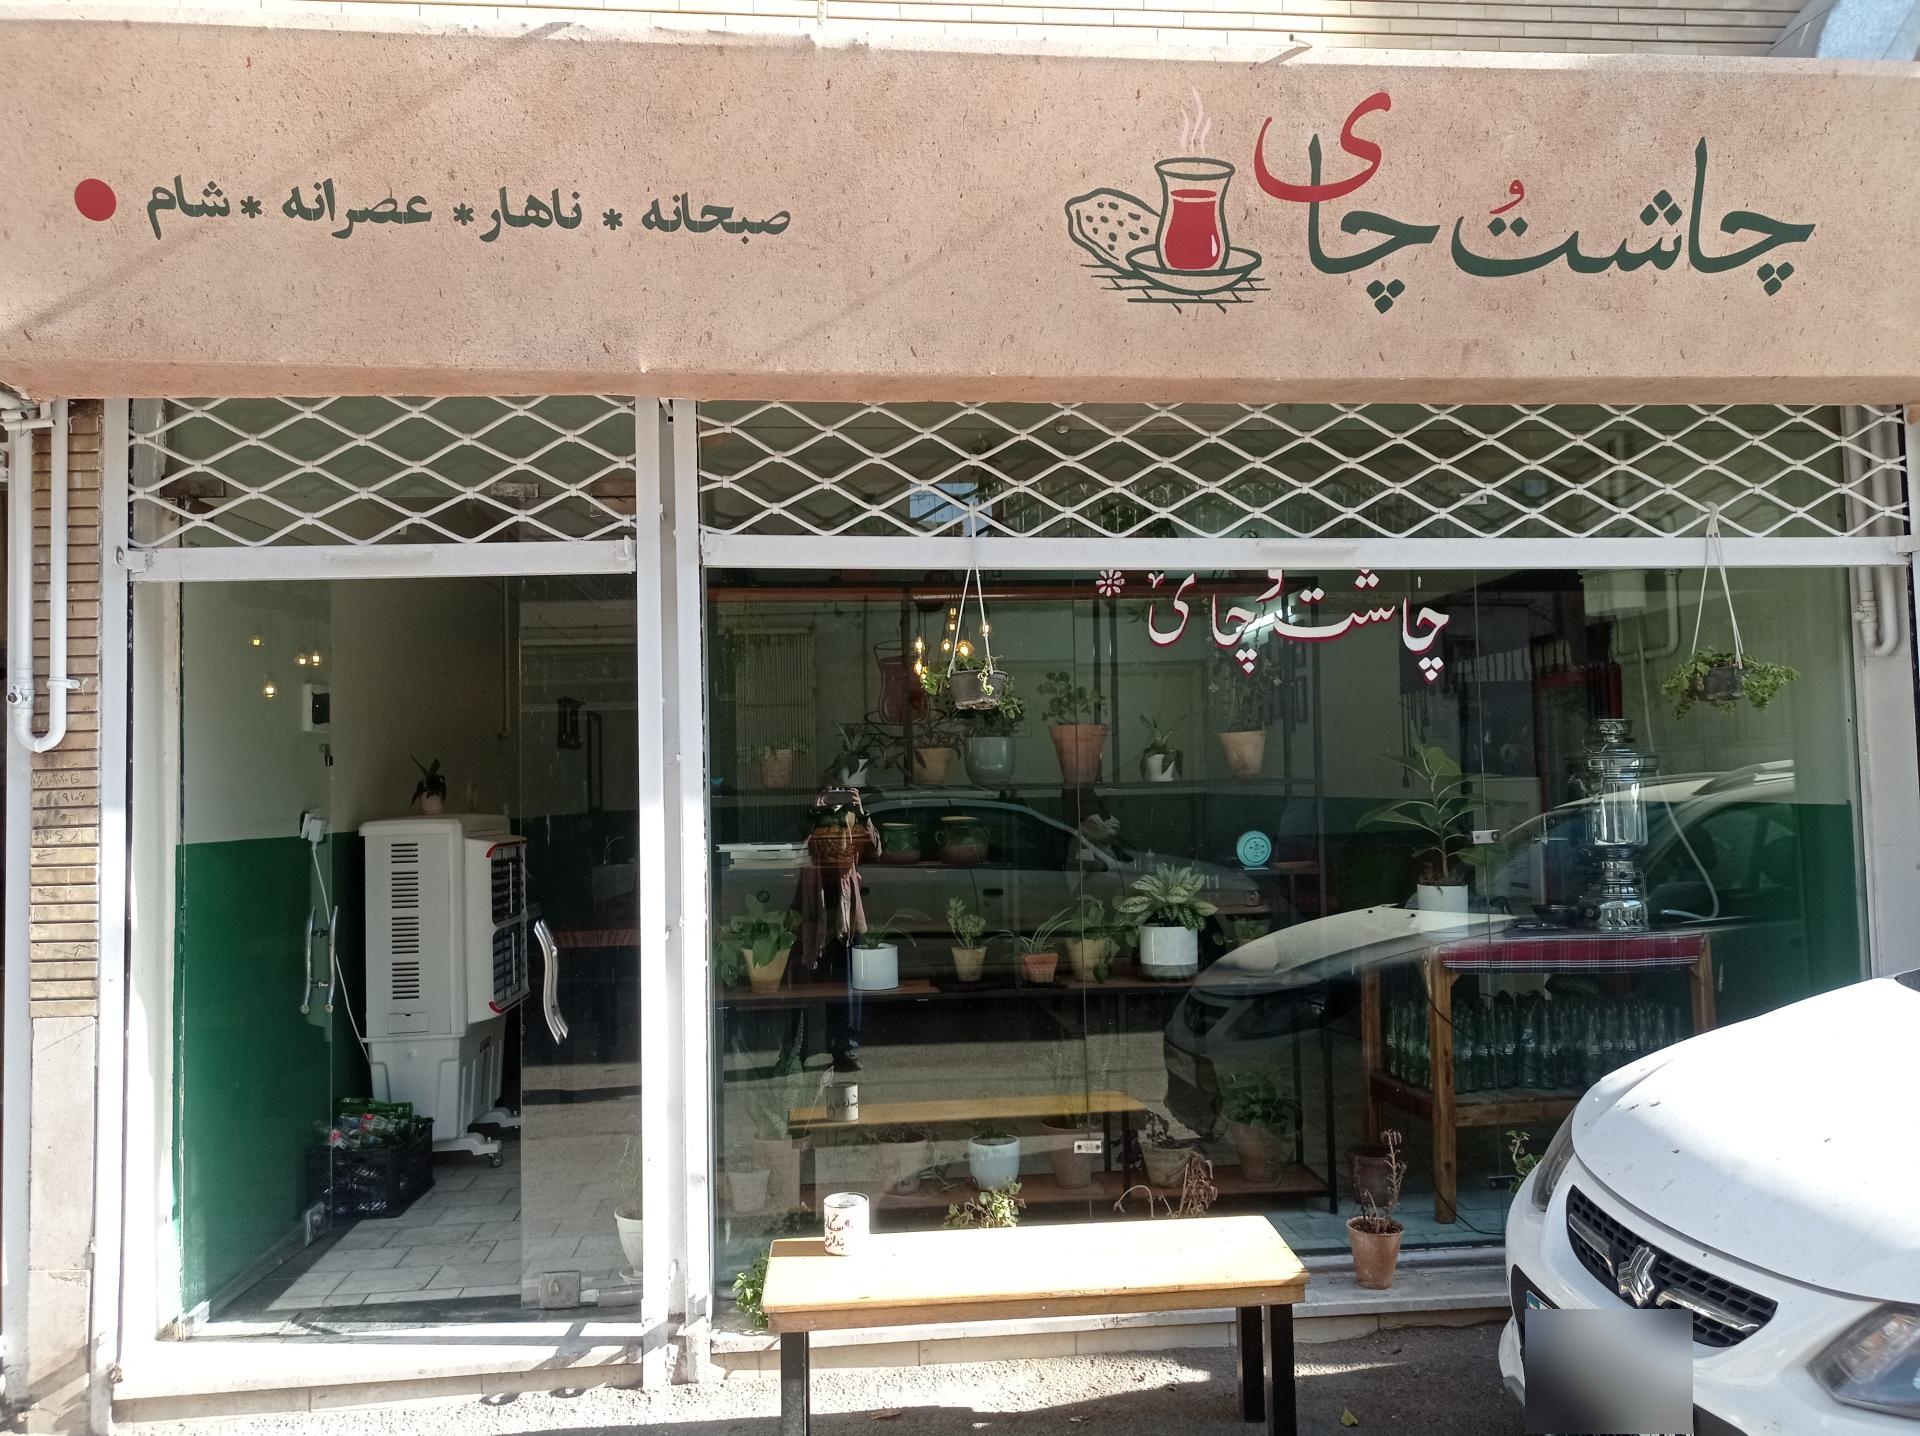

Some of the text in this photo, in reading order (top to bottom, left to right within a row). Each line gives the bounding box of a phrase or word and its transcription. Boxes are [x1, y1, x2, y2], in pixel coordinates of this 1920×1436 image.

[147, 175, 791, 244] صبحانه ناهار عصرانه شام
[1254, 91, 1441, 315] چای
